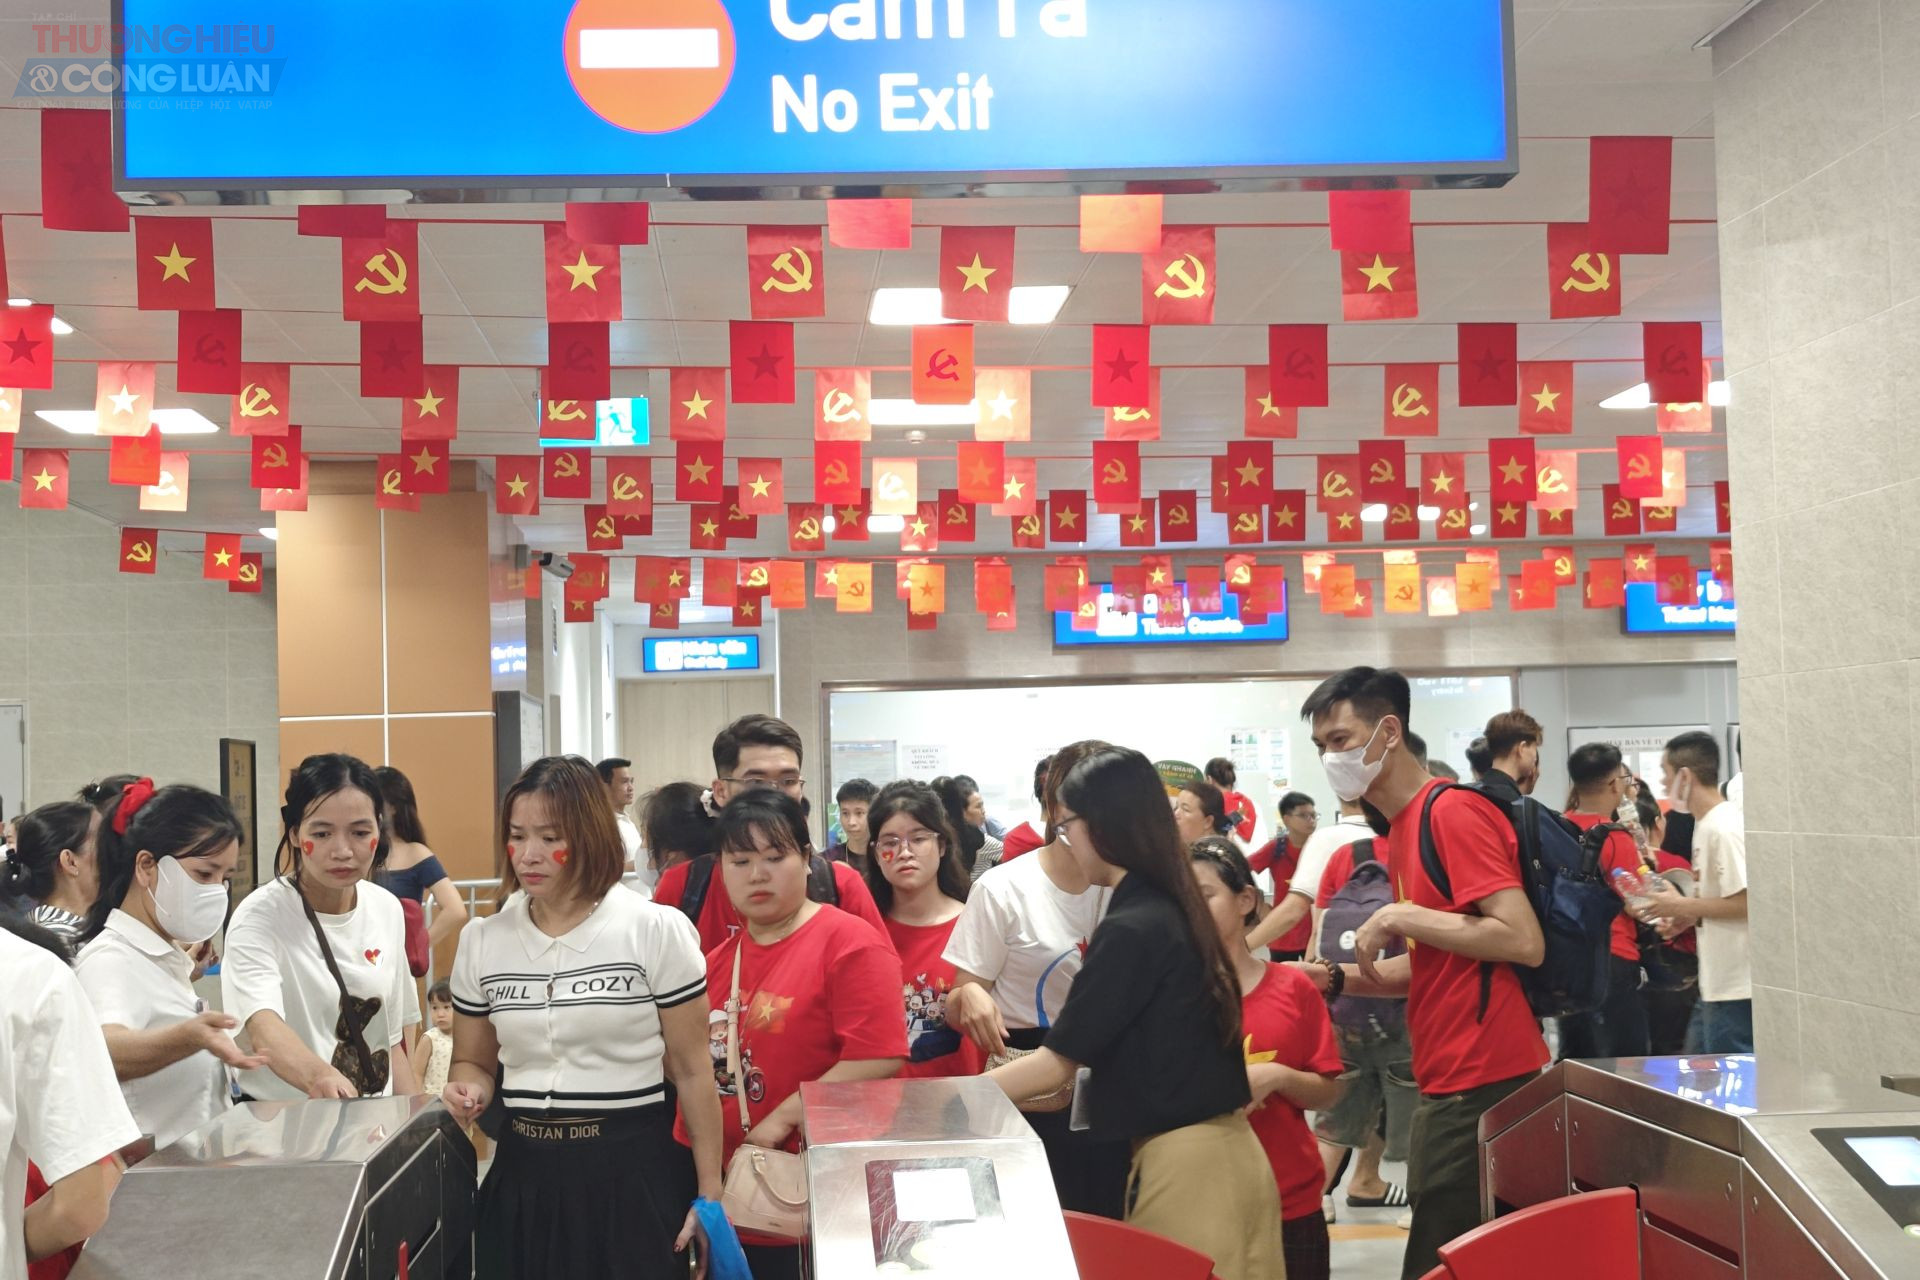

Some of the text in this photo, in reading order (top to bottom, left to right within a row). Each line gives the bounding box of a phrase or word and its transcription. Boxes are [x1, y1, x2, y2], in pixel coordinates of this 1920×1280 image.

[772, 72, 994, 132] No Exit
[485, 976, 635, 1004] CHILL COZY
[512, 1119, 600, 1140] CHRISTAN DIOR
